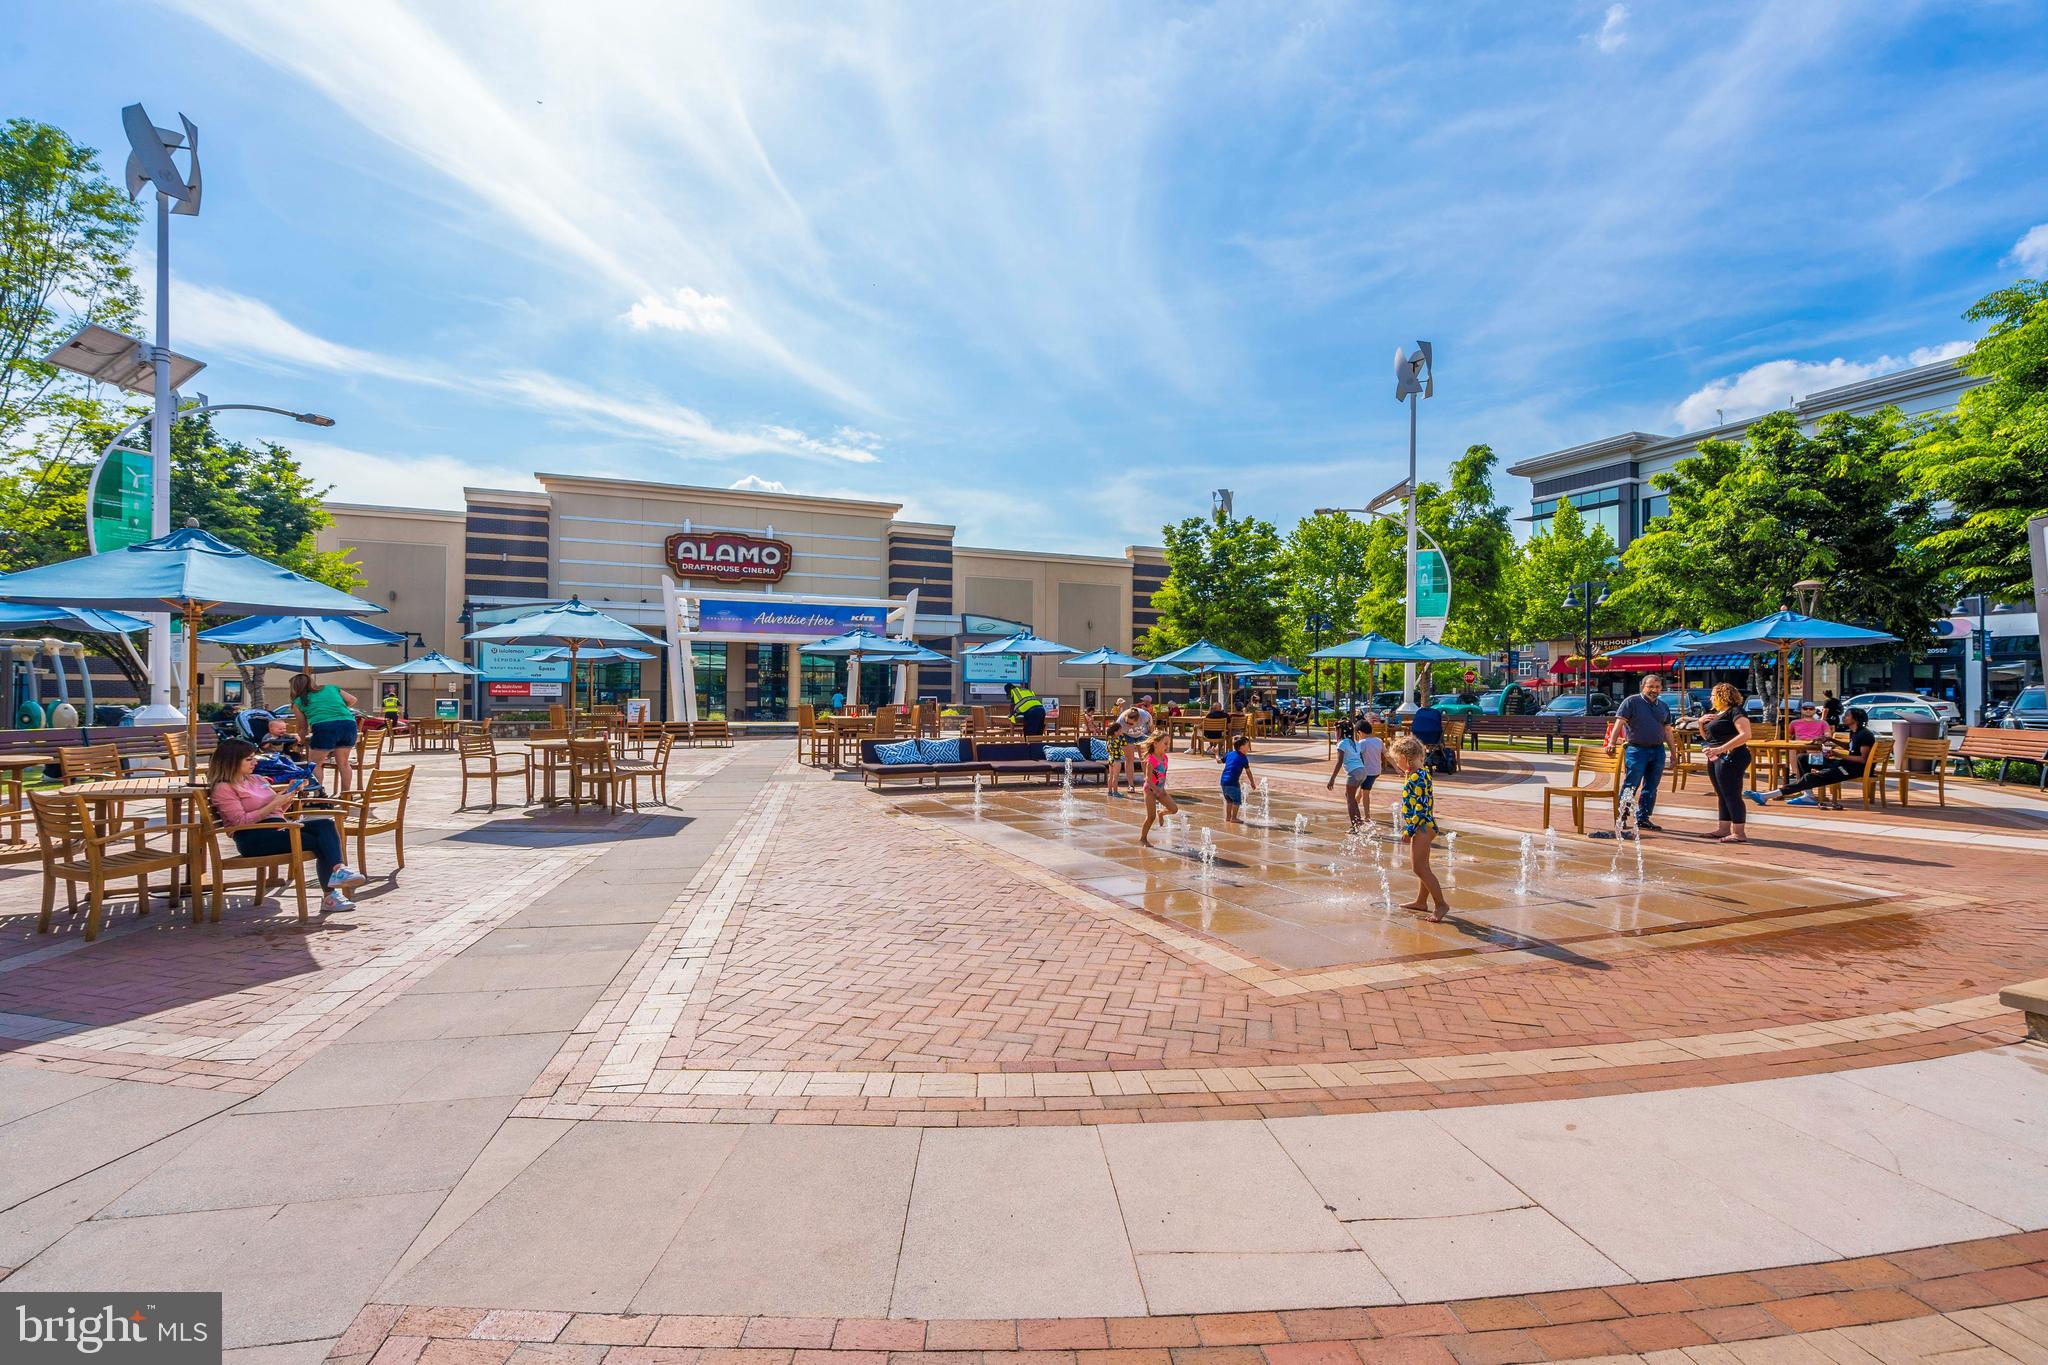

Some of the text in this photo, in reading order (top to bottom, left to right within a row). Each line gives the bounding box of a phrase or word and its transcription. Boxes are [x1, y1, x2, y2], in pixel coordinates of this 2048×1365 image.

[677, 541, 781, 565] ALAMO
[681, 563, 776, 575] DRAFTHOUSE CINEMA
[753, 612, 835, 627] Advertise Here
[851, 613, 875, 622] KITE
